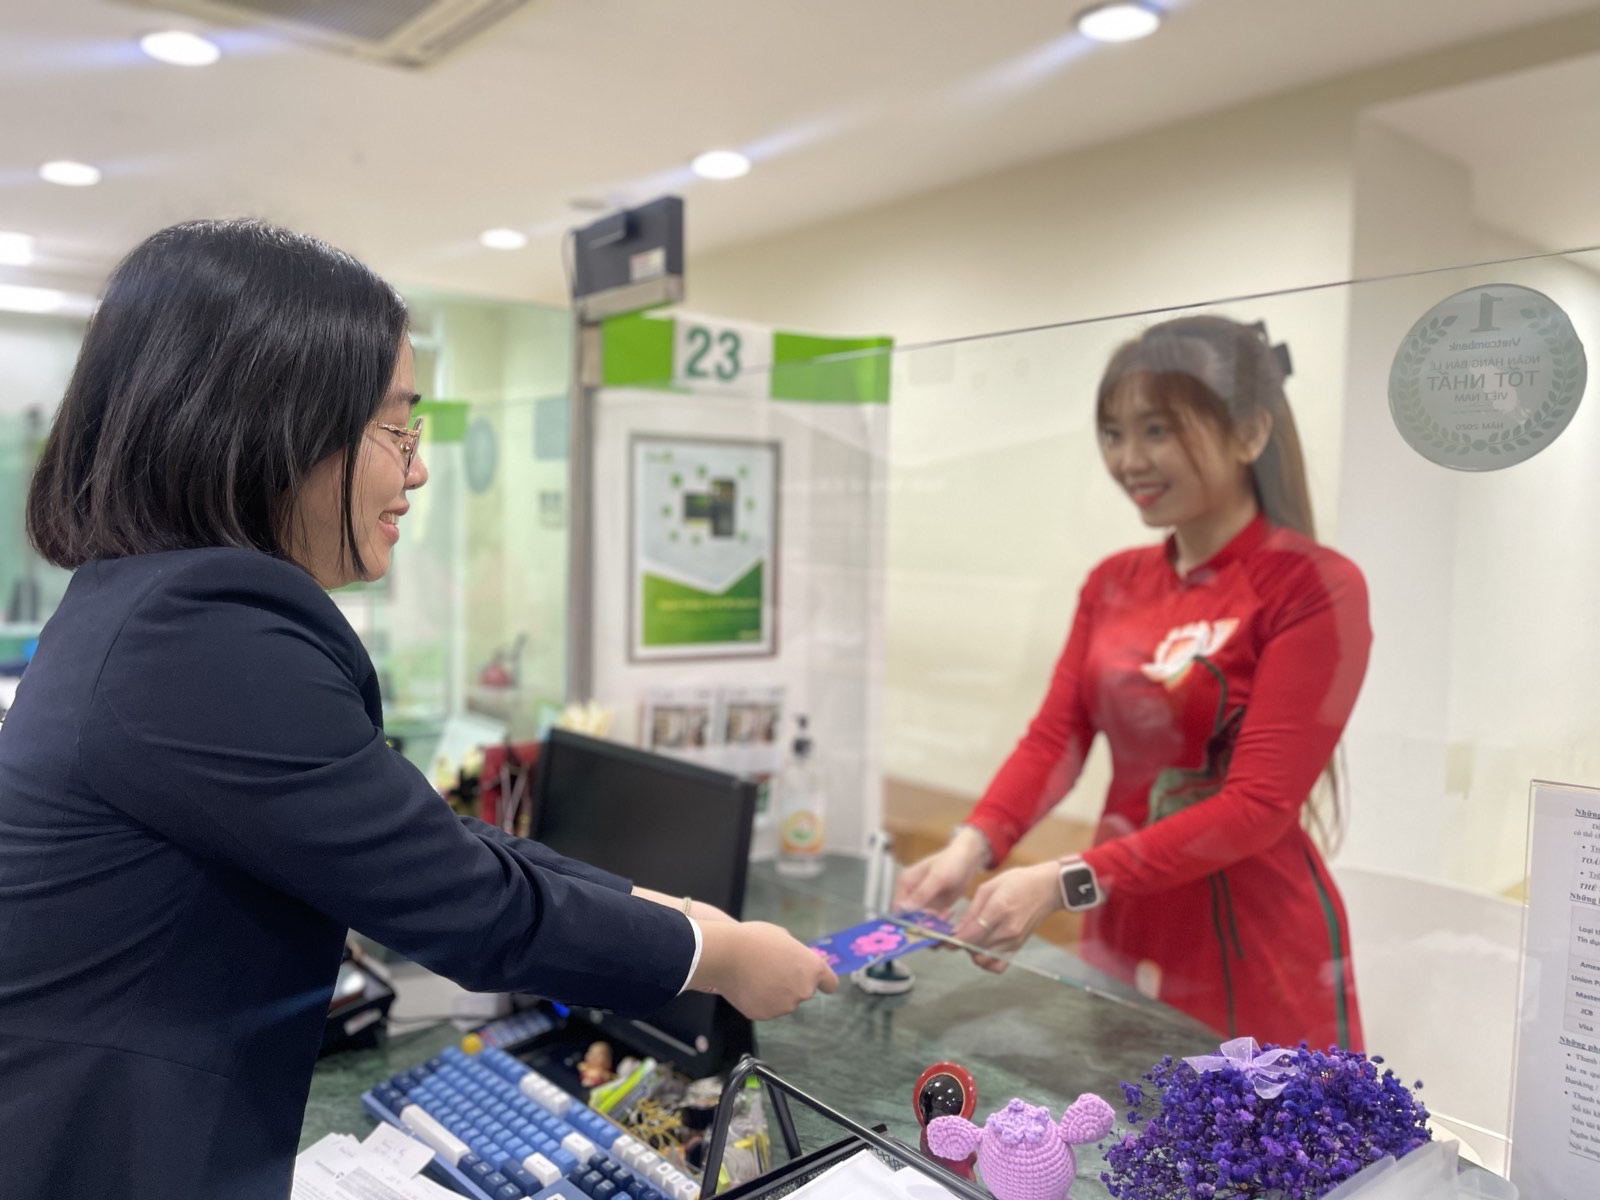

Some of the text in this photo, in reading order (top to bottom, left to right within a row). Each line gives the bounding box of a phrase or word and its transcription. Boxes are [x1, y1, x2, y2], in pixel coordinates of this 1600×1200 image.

[685, 325, 742, 381] 23
[1571, 974, 1593, 985] Union
[1578, 1022, 1594, 1032] Visa
